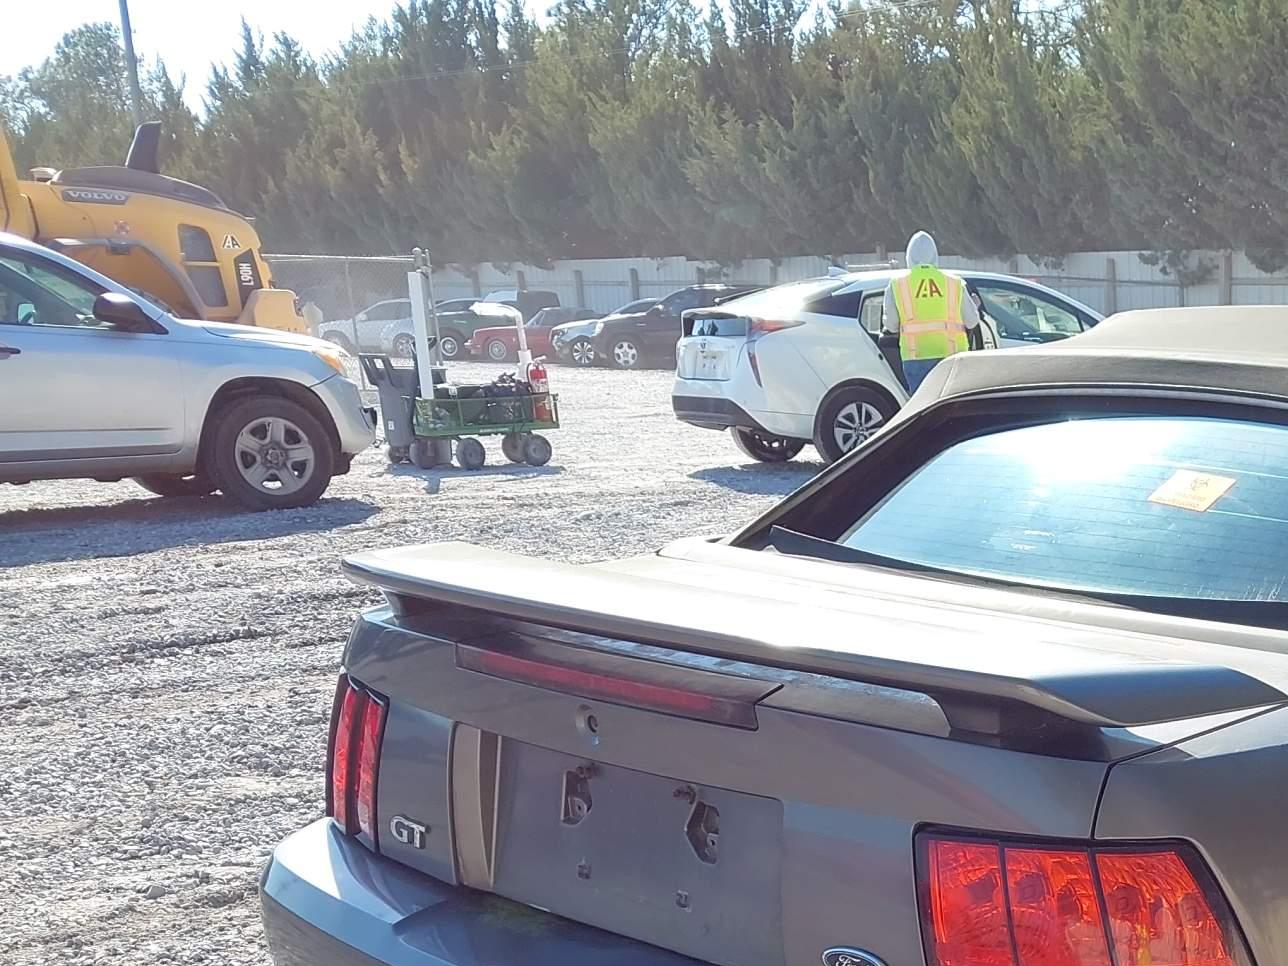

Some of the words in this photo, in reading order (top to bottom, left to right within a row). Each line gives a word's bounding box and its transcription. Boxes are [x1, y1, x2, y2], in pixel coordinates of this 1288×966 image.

[66, 190, 126, 201] VOLVO
[239, 263, 254, 286] L90H
[390, 814, 427, 849] GT
